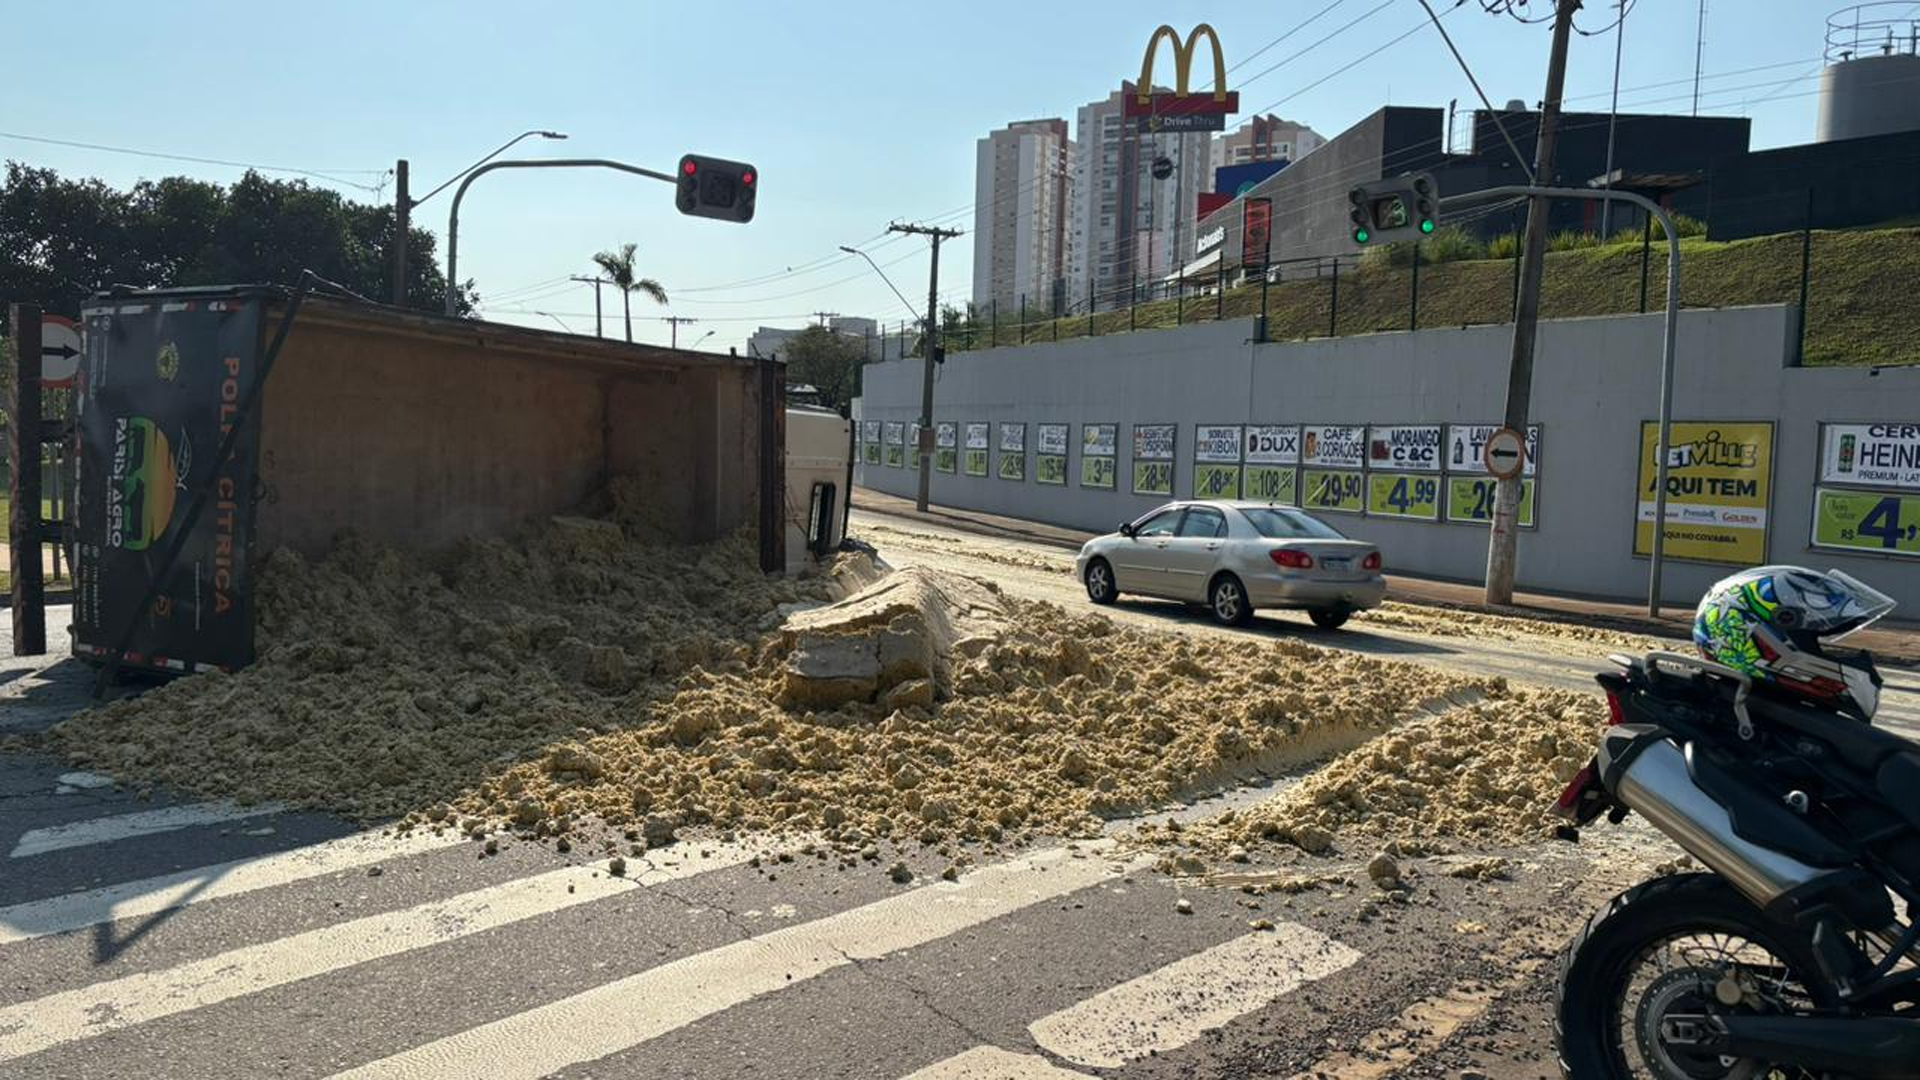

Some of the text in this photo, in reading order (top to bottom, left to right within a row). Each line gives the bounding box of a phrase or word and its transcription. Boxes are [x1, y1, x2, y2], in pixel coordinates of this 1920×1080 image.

[1163, 116, 1192, 127] Drive
[217, 356, 241, 463] POL
[1391, 429, 1440, 447] MORANGO
[1869, 424, 1920, 439] CER
[1260, 436, 1296, 453] DUX
[1858, 469, 1898, 481] PREMIUM
[1319, 474, 1361, 506] 29,90
[1387, 477, 1436, 514] 4,99
[1707, 478, 1757, 497] TEM
[110, 488, 123, 548] AGRO
[1857, 496, 1920, 549] 4,
